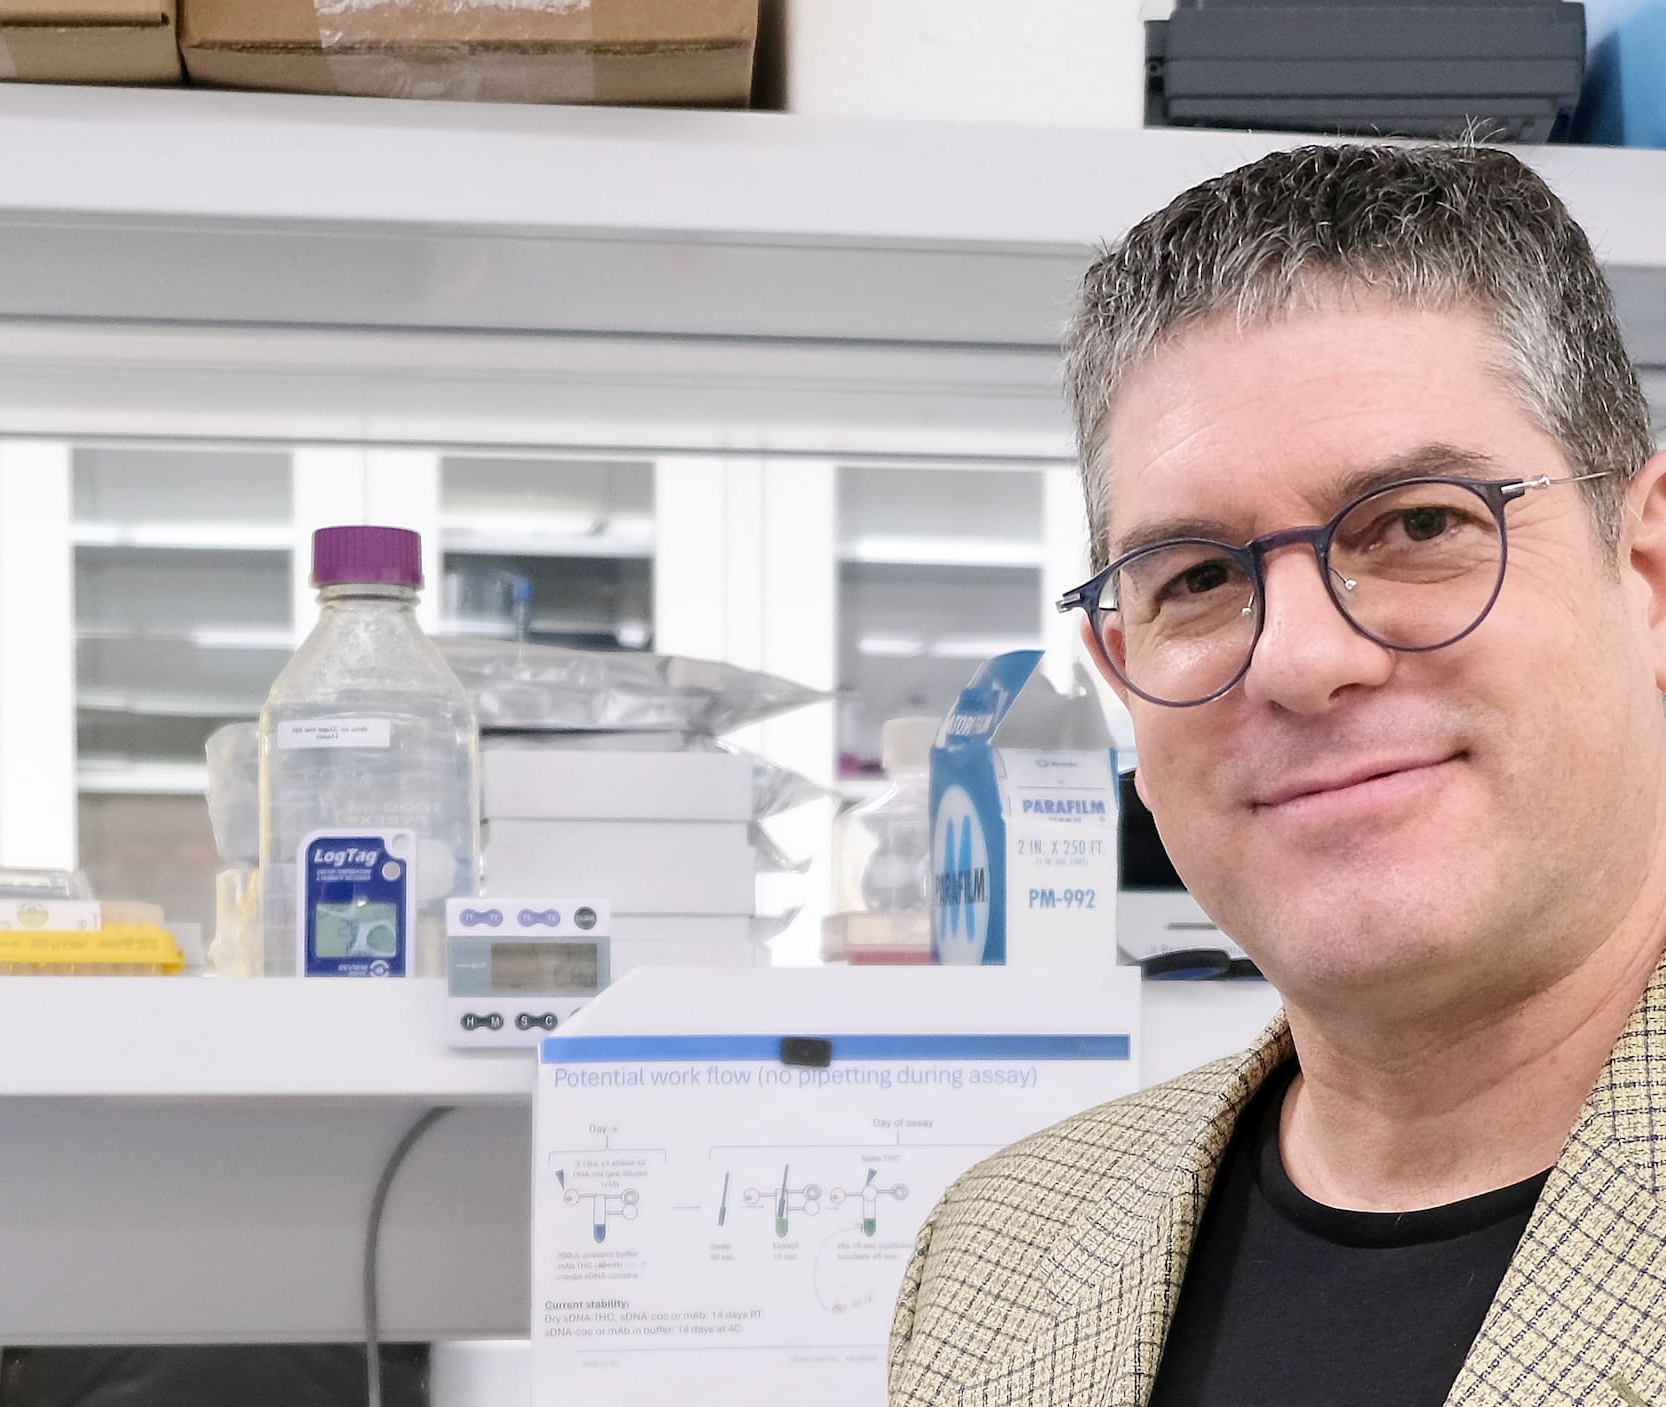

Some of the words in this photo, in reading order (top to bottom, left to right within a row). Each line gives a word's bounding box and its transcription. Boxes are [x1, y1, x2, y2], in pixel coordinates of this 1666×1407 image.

[1023, 799, 1106, 814] PARAFILM
[1018, 839, 1025, 855] 2
[1029, 839, 1045, 855] IN.
[1051, 839, 1059, 855] X
[1064, 839, 1086, 855] 250
[313, 848, 378, 866] LogTag
[935, 866, 986, 905] PARAFILM
[1028, 888, 1096, 909] PM-992
[466, 1016, 475, 1026] H
[490, 1016, 500, 1026] M
[520, 1015, 528, 1026] S
[545, 1015, 553, 1026] C
[554, 1067, 645, 1087] Potential
[651, 1066, 701, 1086] work
[705, 1065, 752, 1084] flow
[757, 1065, 792, 1088] (no
[797, 1064, 893, 1091] pipetting
[896, 1064, 965, 1090] during
[967, 1065, 1039, 1090] assay)
[589, 1123, 606, 1135] Day
[872, 1118, 891, 1129] Day
[894, 1118, 903, 1127] of
[906, 1119, 933, 1129] assay
[544, 1300, 584, 1310] Current
[585, 1299, 630, 1310] stability:
[544, 1313, 562, 1325] Dry
[563, 1312, 617, 1323] sDNA-THC,
[619, 1311, 670, 1322] sDNA-coc
[672, 1313, 681, 1321] or
[712, 1310, 722, 1320] 14
[724, 1310, 749, 1322] days
[750, 1309, 762, 1319] RT
[544, 1326, 594, 1337] sDNA-coc
[595, 1327, 606, 1336] or
[607, 1326, 630, 1336] mAb
[632, 1326, 641, 1335] in
[643, 1324, 675, 1335] buffer:
[678, 1324, 689, 1334] 14
[691, 1324, 715, 1336] days
[717, 1325, 726, 1334] at
[727, 1323, 742, 1334] 4C
